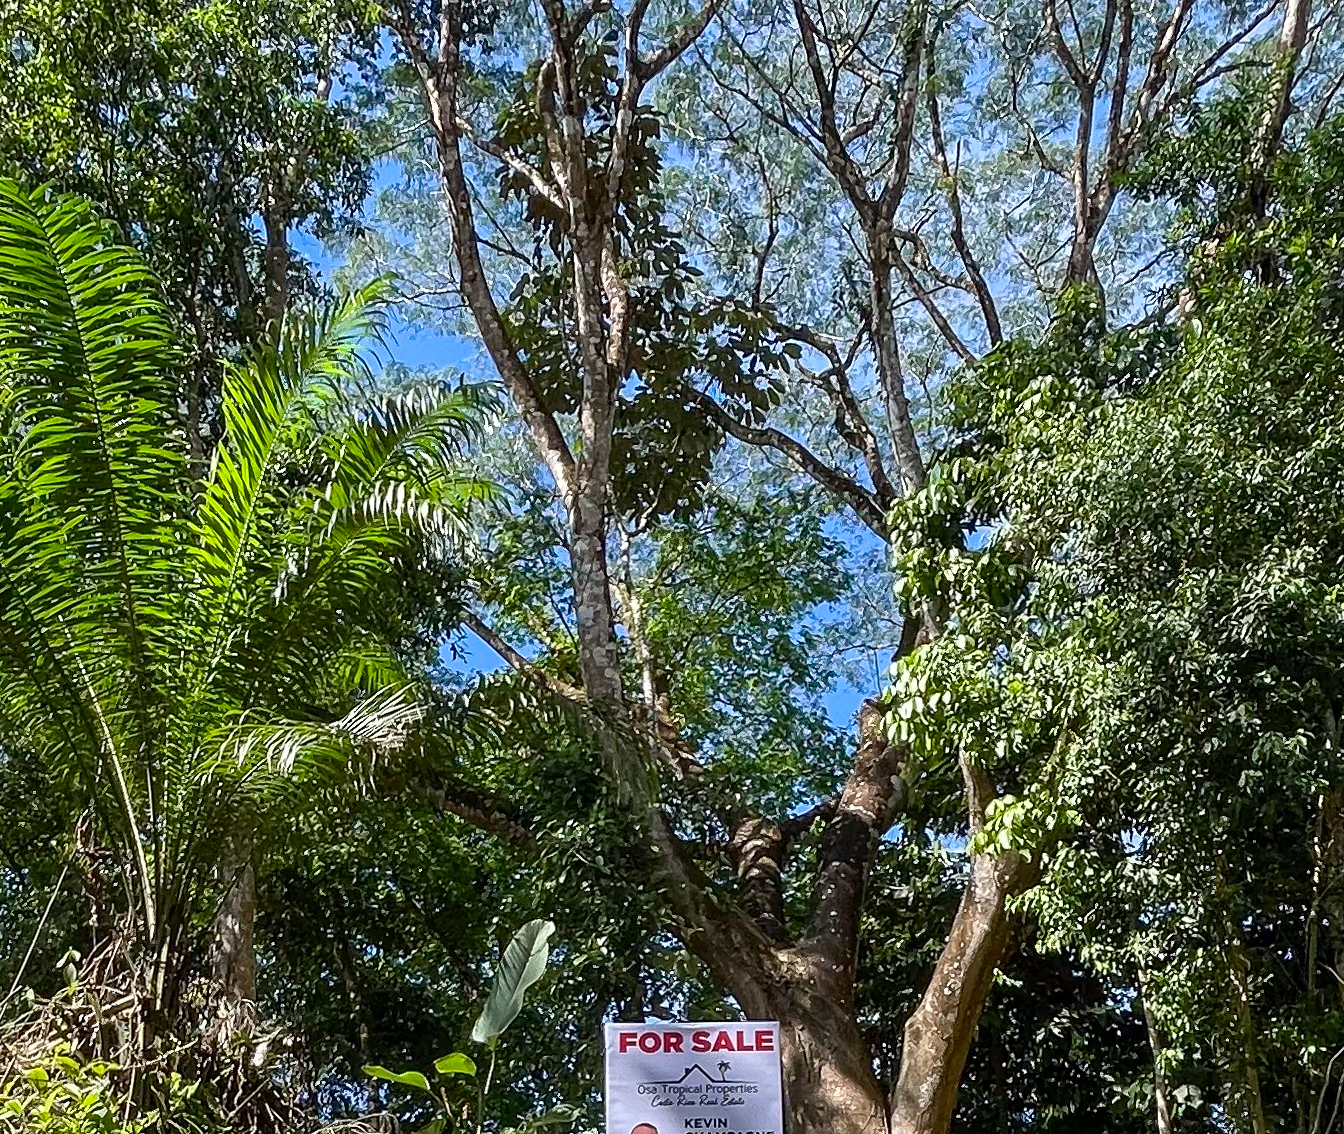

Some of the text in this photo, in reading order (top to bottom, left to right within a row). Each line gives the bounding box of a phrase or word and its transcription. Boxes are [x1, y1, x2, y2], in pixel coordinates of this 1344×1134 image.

[619, 1031, 774, 1053] FOR SALE
[637, 1084, 758, 1096] Osa Tropical Properties
[699, 1094, 718, 1106] Real
[720, 1094, 745, 1106] Estate
[684, 1118, 728, 1129] KEVIN
